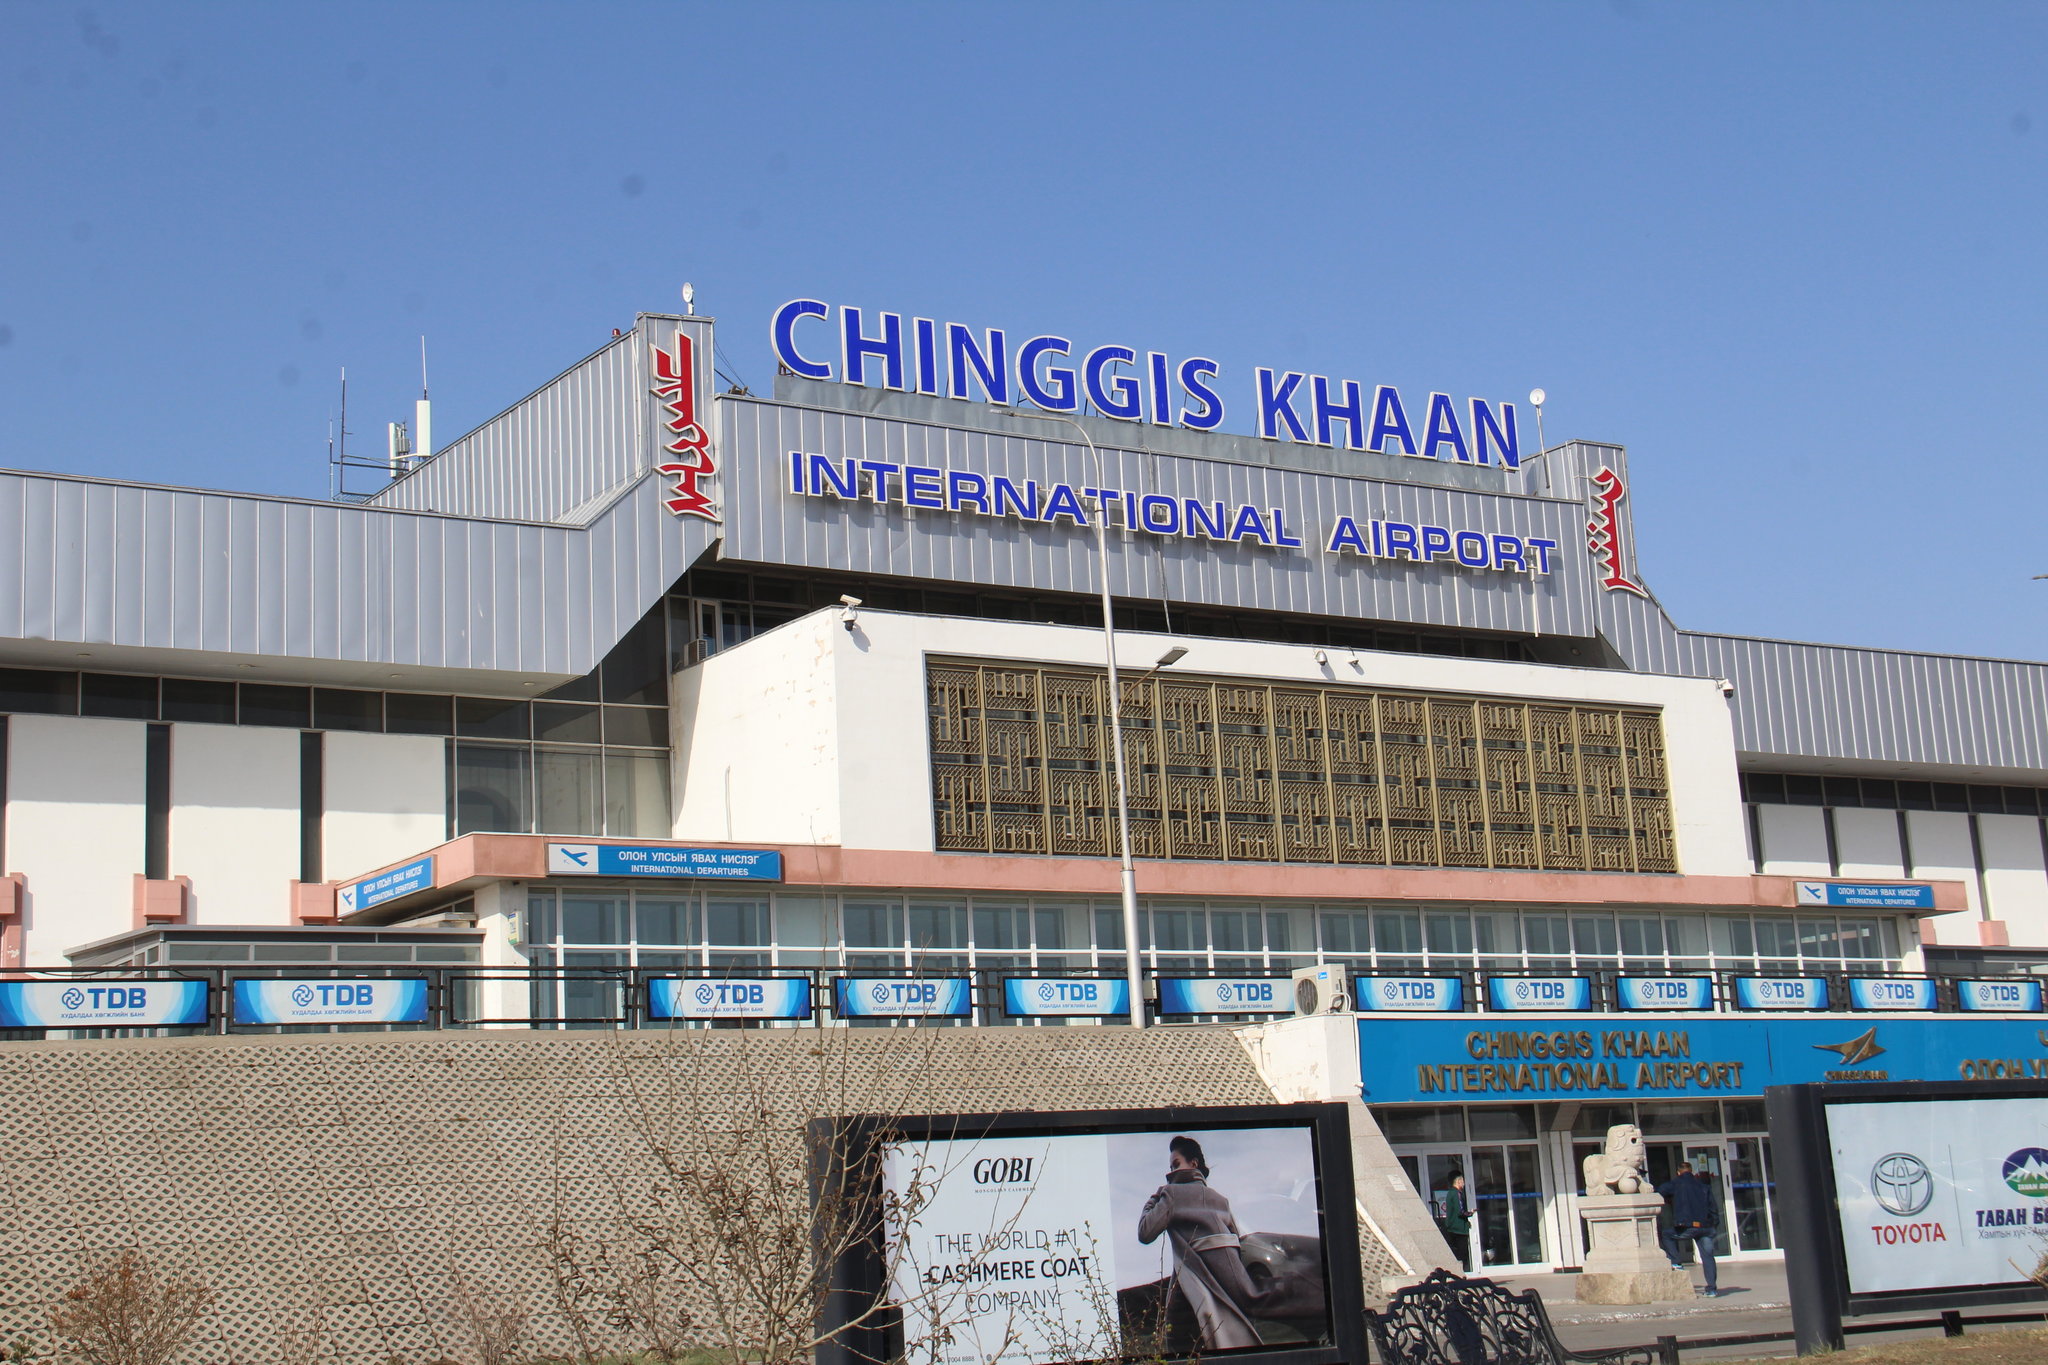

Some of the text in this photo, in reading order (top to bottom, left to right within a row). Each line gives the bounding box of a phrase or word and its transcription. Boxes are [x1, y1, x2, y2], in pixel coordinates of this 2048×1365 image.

[770, 298, 1520, 471] CHINGGIS KHAAN
[788, 450, 1557, 575] INTERNATIONAL AIRPORT
[618, 851, 760, 865] ОЛОН УЛСЫН ЯВАХ НИСЛЭГ
[631, 865, 749, 876] INTERNATIONAL DEPARTURES
[87, 988, 147, 1009] TDB
[316, 984, 374, 1006] TDB
[715, 984, 764, 1004] TDB
[891, 984, 937, 1003] TDB
[1055, 983, 1098, 1001] TDB
[1232, 983, 1273, 1001] TDB
[1399, 982, 1435, 999] TDB
[1530, 982, 1565, 999] TDB
[1655, 982, 1688, 998] TDB
[1772, 982, 1805, 998] TDB
[1884, 983, 1915, 999] TDB
[1991, 985, 2020, 1001] TDB
[1465, 1031, 1690, 1058] CHINGGIS KHAAN
[1418, 1061, 1744, 1092] INTERNATIONAL AIRPORT
[973, 1157, 1035, 1185] GOBI
[1976, 1208, 2027, 1227] ТАВАН
[935, 1228, 1078, 1254] THE WORLD #1
[1871, 1222, 1947, 1245] TOYOTA
[929, 1256, 1089, 1284] CASHMERE COAT
[965, 1289, 1059, 1313] COMPANY
